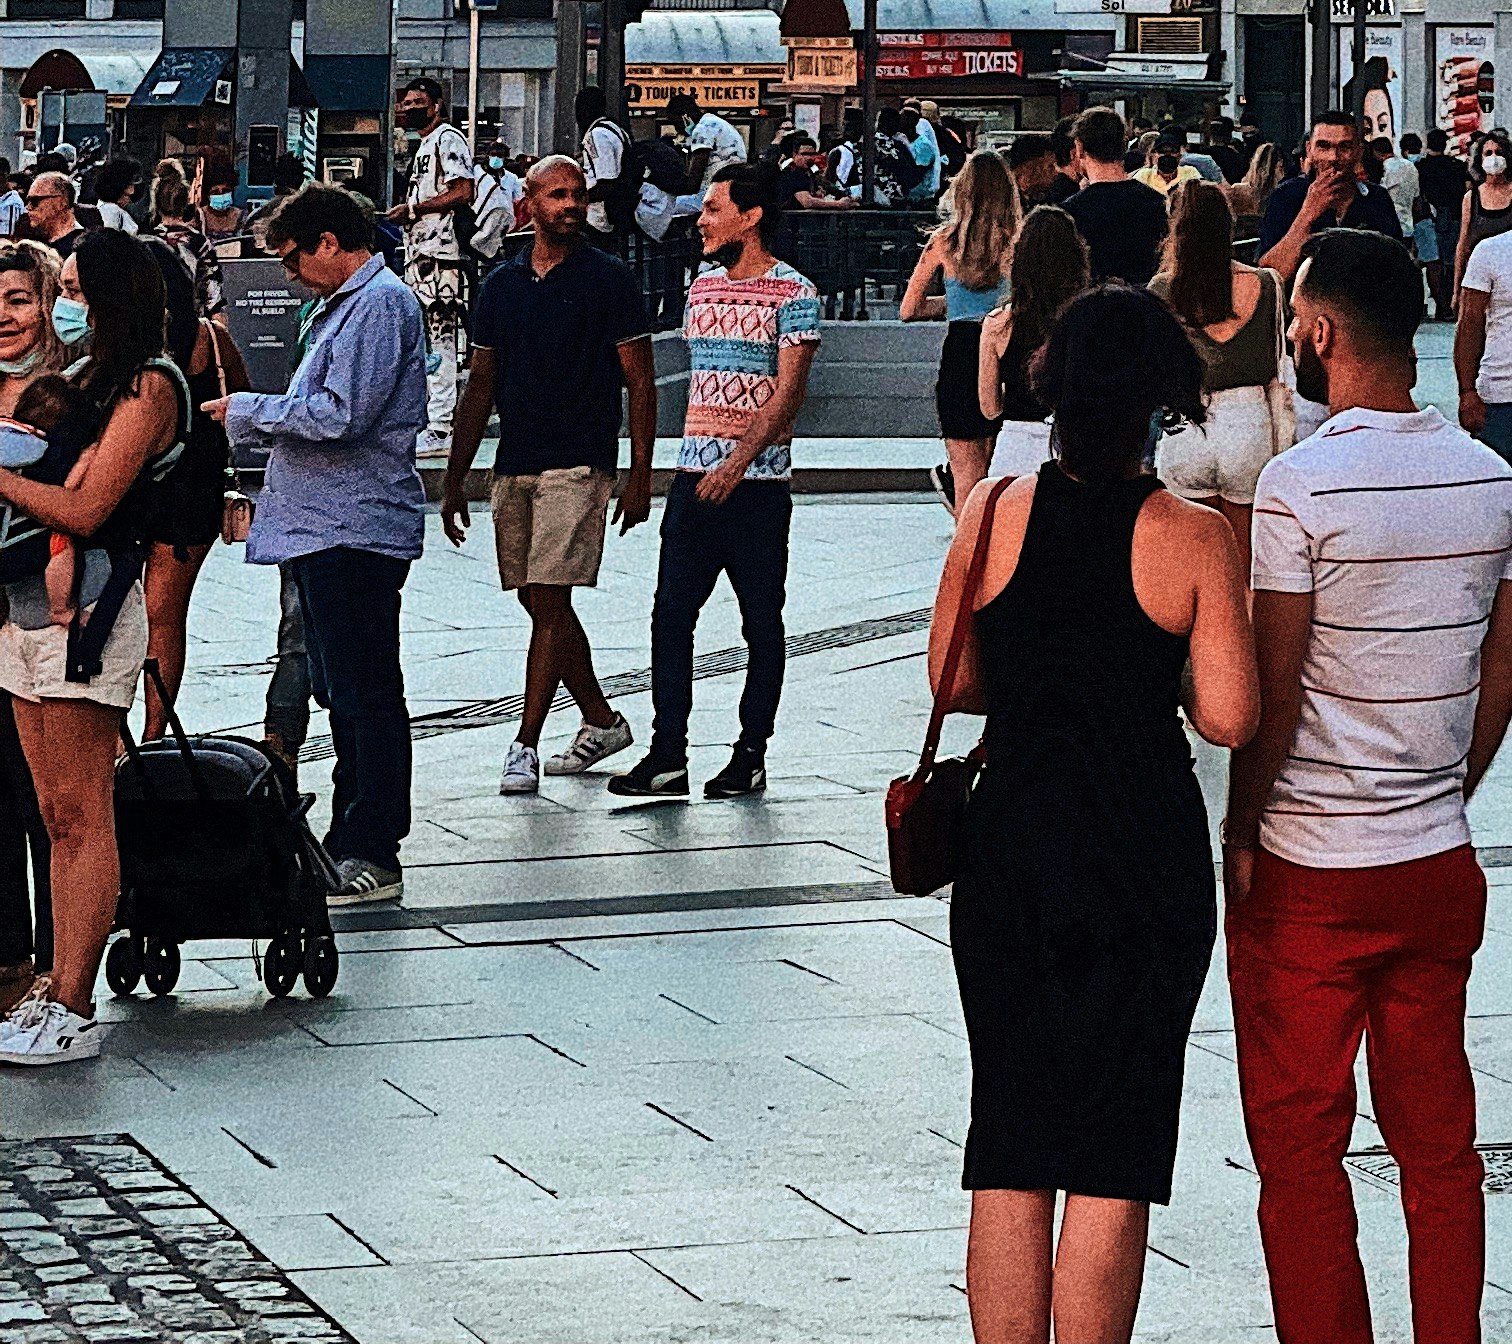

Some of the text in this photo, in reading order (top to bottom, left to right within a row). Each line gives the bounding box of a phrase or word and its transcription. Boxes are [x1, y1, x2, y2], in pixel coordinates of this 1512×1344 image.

[963, 51, 1018, 74] TICKETS
[645, 86, 686, 100] TOURS
[704, 86, 756, 100] TICKETS
